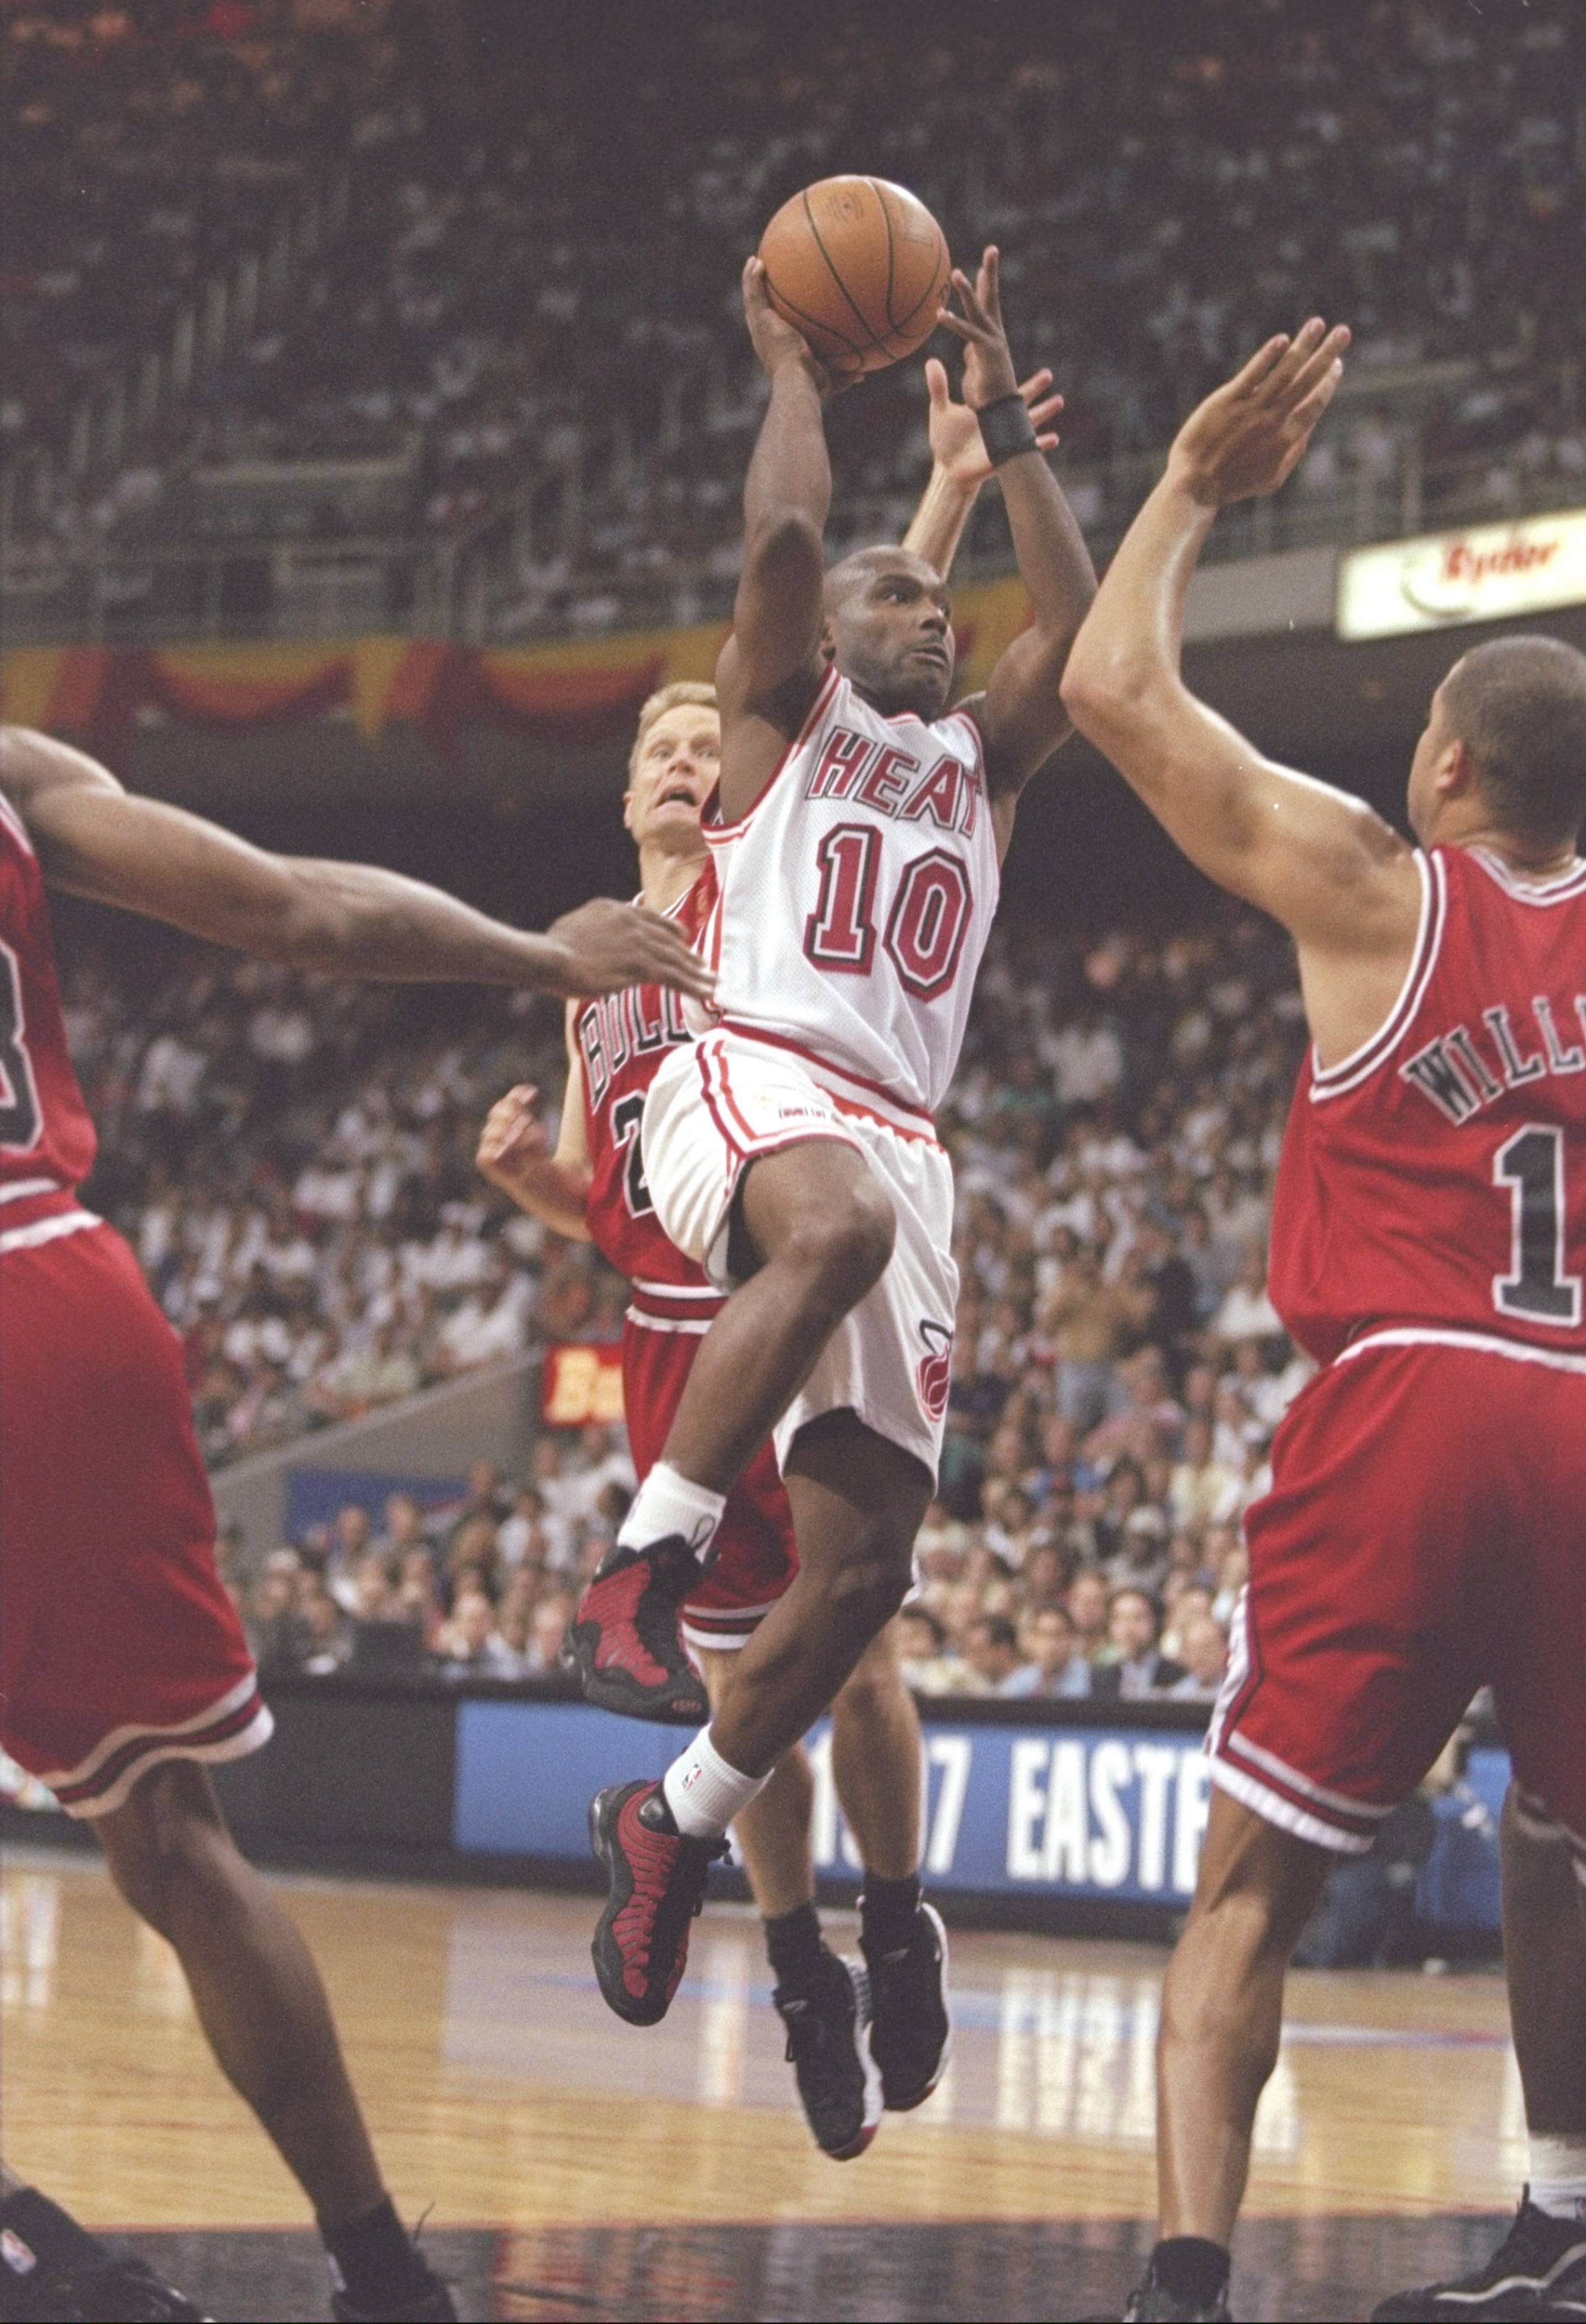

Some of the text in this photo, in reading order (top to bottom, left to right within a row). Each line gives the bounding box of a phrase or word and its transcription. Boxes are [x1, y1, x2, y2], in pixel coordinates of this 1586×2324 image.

[807, 725, 983, 840] HEAT
[803, 822, 973, 1003] 10
[1492, 1123, 1582, 1327] 1
